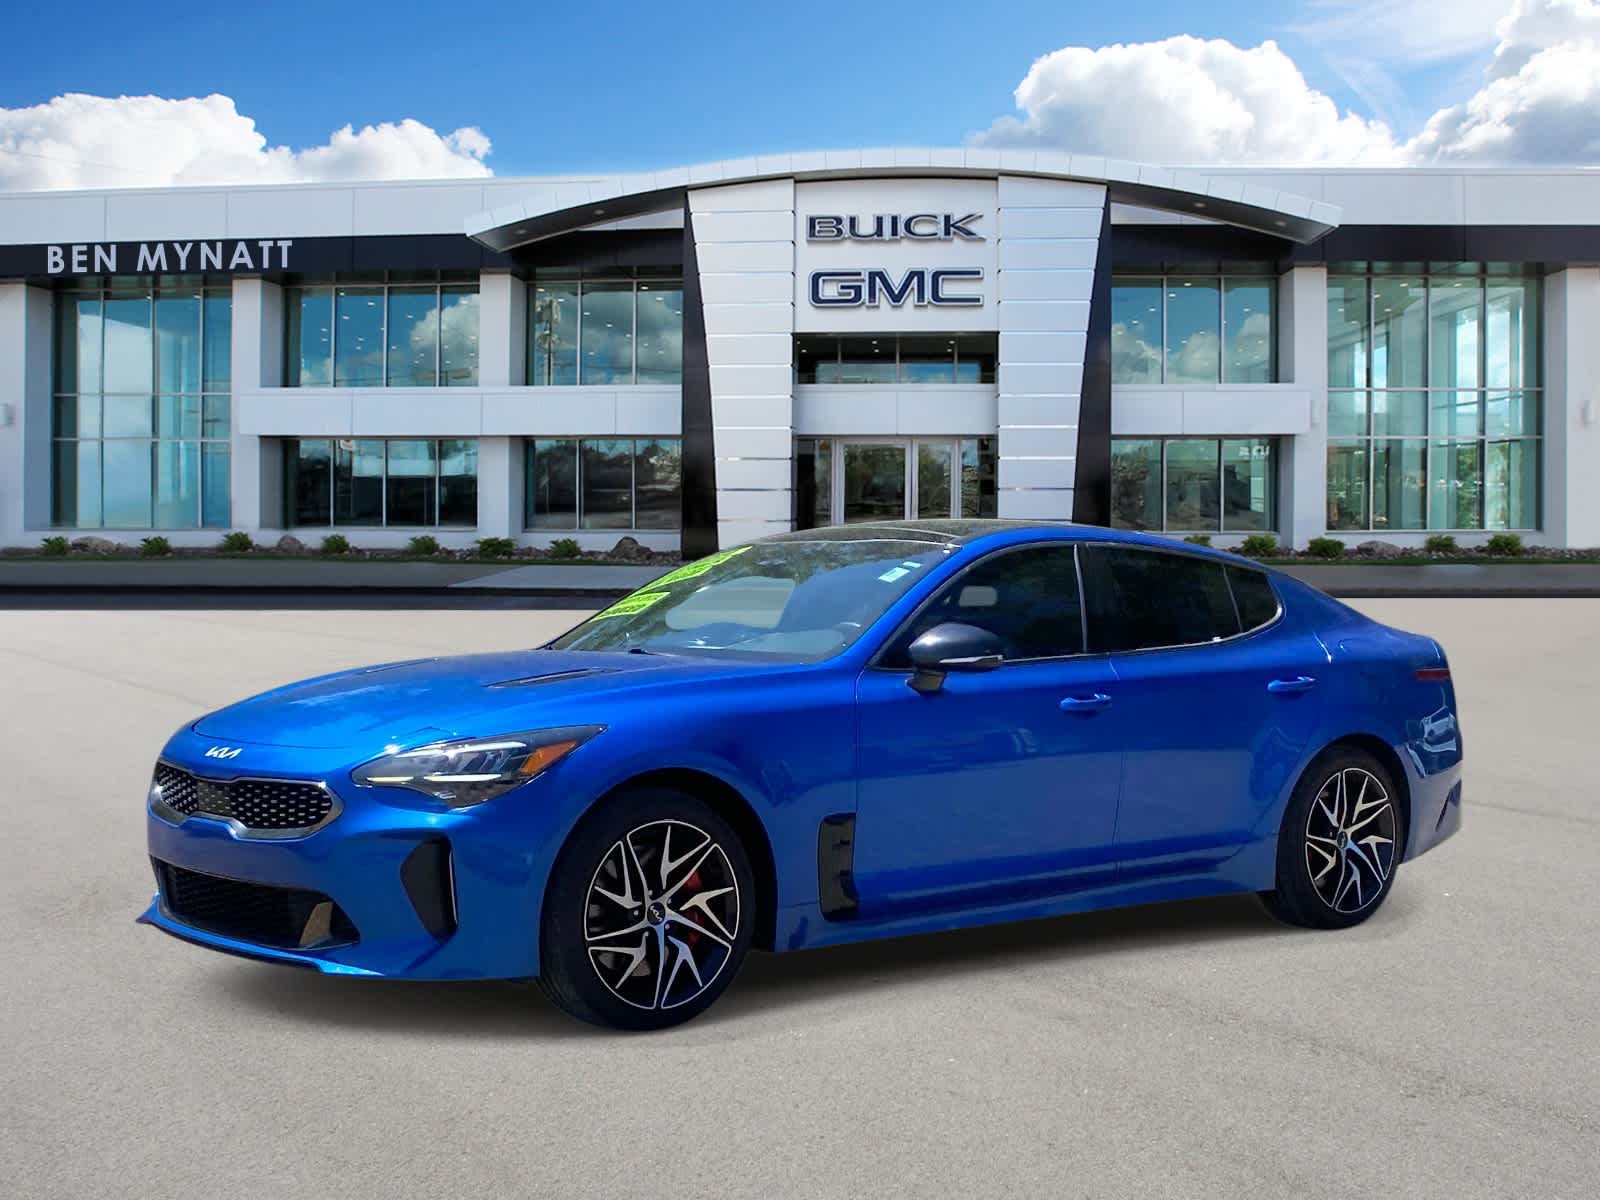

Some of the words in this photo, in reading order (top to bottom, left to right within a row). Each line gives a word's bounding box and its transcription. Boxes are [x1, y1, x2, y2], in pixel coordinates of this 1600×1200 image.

[806, 214, 985, 242] BUICK
[47, 245, 117, 274] BEN
[136, 240, 293, 272] MYNATT
[808, 267, 984, 308] GMC
